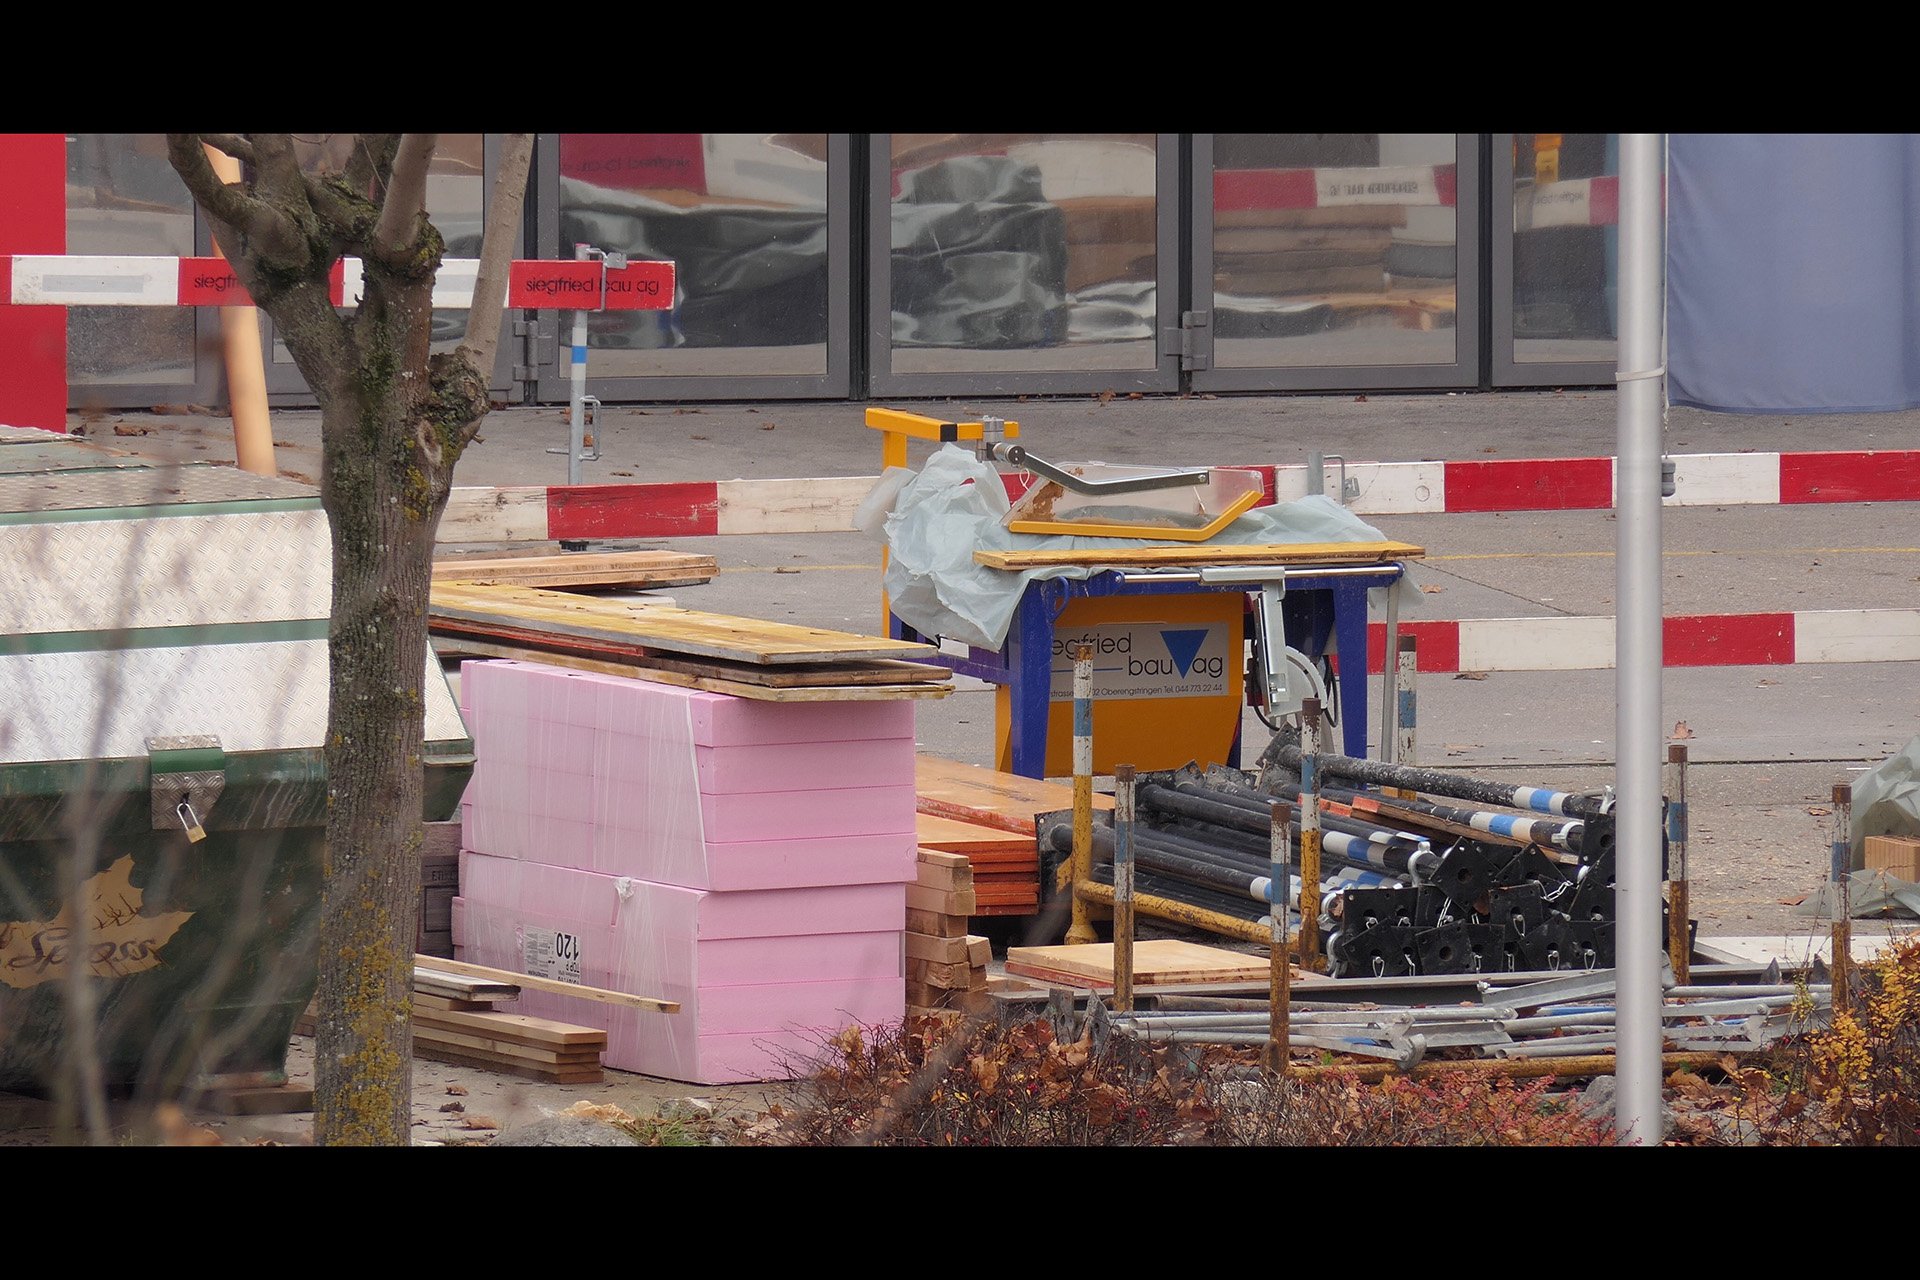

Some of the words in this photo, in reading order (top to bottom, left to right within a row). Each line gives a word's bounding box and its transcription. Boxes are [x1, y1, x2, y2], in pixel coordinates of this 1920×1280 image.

[526, 277, 594, 296] siegfried
[598, 277, 632, 293] bau
[636, 279, 659, 296] ag
[1128, 655, 1173, 676] bau
[1192, 655, 1223, 679] ag
[1101, 685, 1163, 697] Oberengstringen
[1175, 684, 1189, 694] 044
[1190, 683, 1202, 693] 773
[1202, 683, 1212, 692] 22
[1213, 683, 1223, 692] 44
[557, 932, 579, 961] 120
